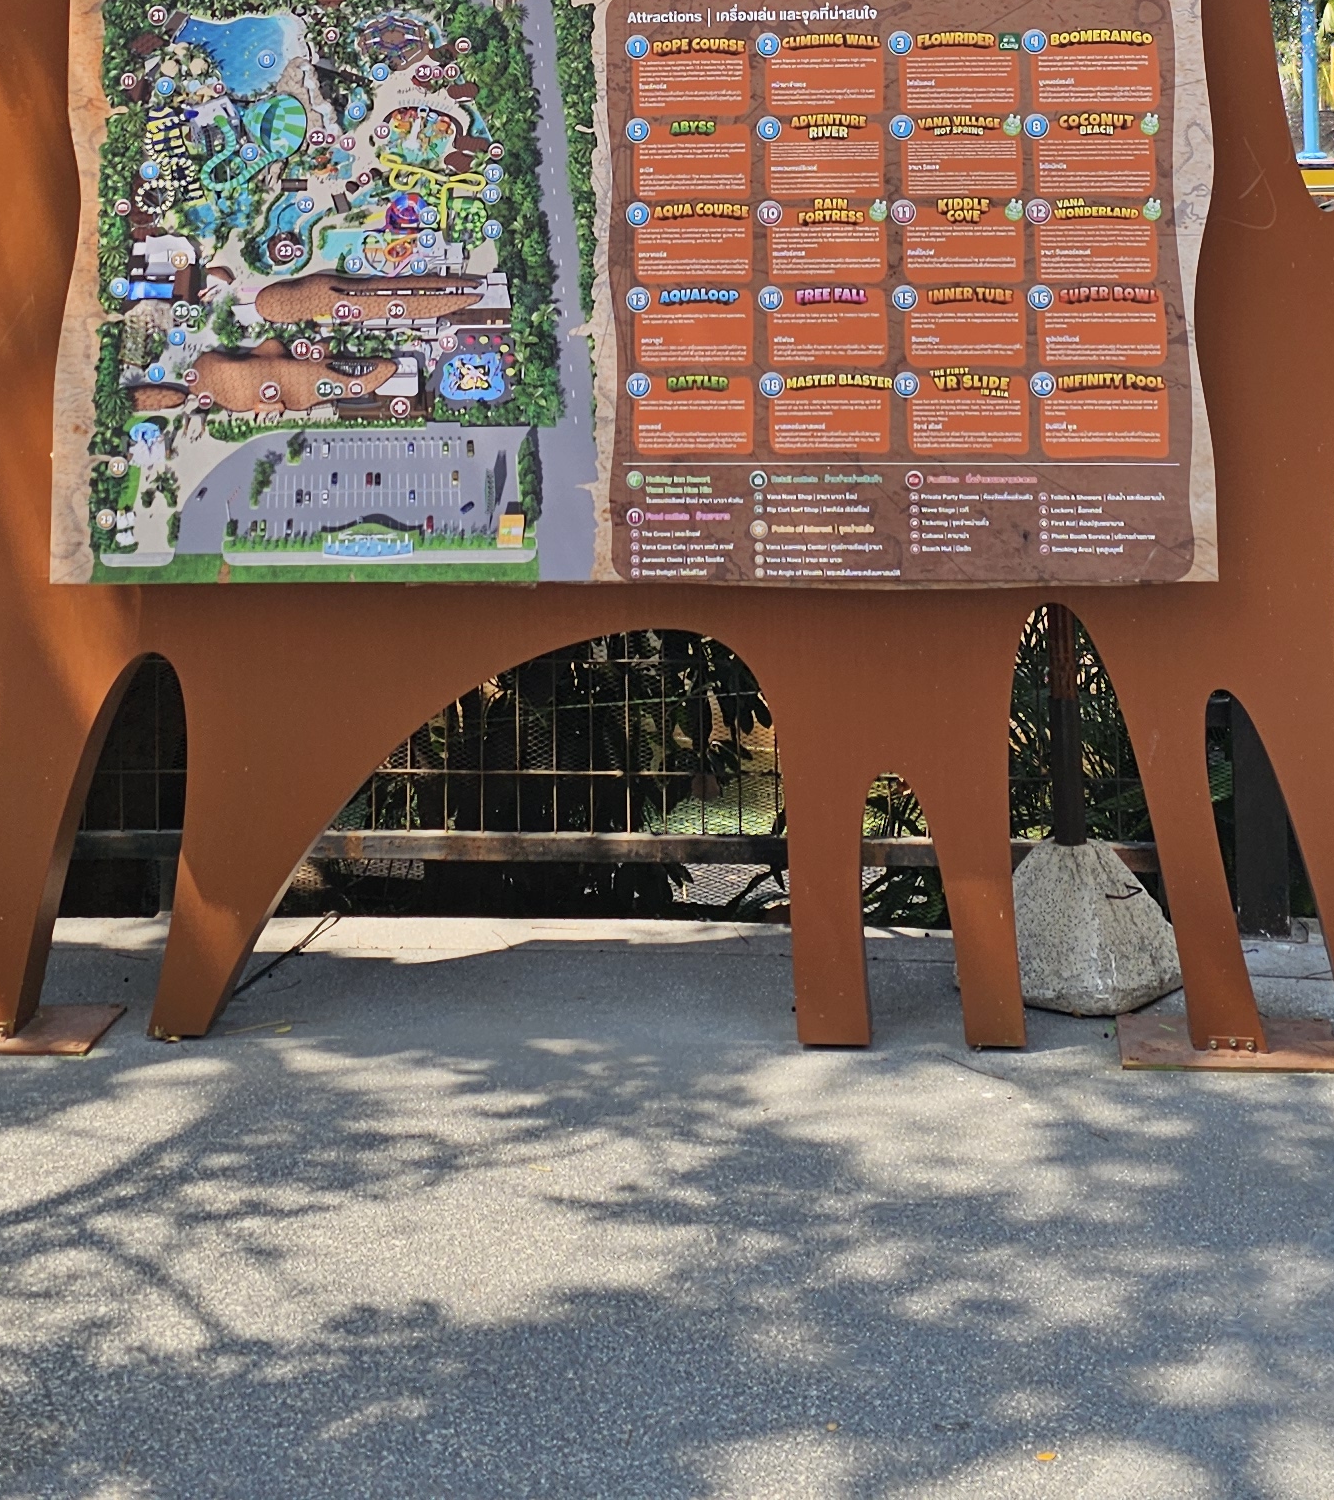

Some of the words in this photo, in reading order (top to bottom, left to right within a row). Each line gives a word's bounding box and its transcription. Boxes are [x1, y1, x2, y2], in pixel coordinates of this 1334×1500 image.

[152, 12, 163, 20] 31
[627, 11, 702, 24] Attractions
[764, 40, 772, 50] 2
[782, 34, 843, 49] CLIMBING
[846, 34, 881, 47] WALL
[896, 38, 905, 49] 3
[917, 32, 995, 48] FLOWRIDER
[1030, 36, 1039, 47] 4
[1050, 29, 1153, 46] BOOMERANGO
[634, 42, 641, 52] 1
[652, 38, 689, 53] ROPE
[692, 37, 746, 52] COURSE
[377, 69, 383, 77] 9
[418, 68, 430, 76] 24
[633, 125, 641, 136] 5
[671, 121, 716, 134] ABYSS
[765, 123, 773, 134] 6
[791, 114, 866, 128] ADVENTURE
[898, 121, 906, 132] 7
[918, 116, 951, 129] VANA
[953, 116, 1001, 129] VILLAGE
[1033, 121, 1041, 131] 8
[1059, 114, 1134, 128] COCONUT
[376, 127, 388, 136] 10
[809, 126, 848, 139] RIVER
[934, 126, 951, 135] HOT
[952, 126, 984, 135] SPRING
[1079, 125, 1113, 134] BEACH
[312, 133, 323, 141] 22
[343, 139, 353, 147] 11
[247, 149, 252, 157] 5
[488, 170, 499, 179] 19
[633, 210, 642, 220] 9
[654, 203, 692, 218] AQUA
[696, 203, 750, 217] COURSE
[762, 208, 776, 218] 10
[814, 198, 847, 210] RAIN
[897, 207, 910, 218] 11
[937, 198, 990, 212] KIDDLE
[1031, 206, 1046, 217] 12
[1056, 198, 1085, 207] VANA
[1053, 206, 1139, 219] WONDERLAND
[422, 212, 434, 221] 16
[798, 211, 864, 224] FORTRESS
[947, 210, 981, 223] COVE
[487, 226, 498, 234] 17
[422, 236, 433, 244] 15
[280, 247, 291, 255] 23
[413, 262, 424, 270] 14
[117, 284, 122, 292] 3
[631, 294, 646, 304] 13
[659, 287, 739, 303] AQUALOOP
[763, 293, 778, 304] 14
[795, 288, 830, 303] FREE
[834, 288, 868, 302] FALL
[898, 292, 912, 304] 15
[927, 287, 974, 302] INNER
[976, 287, 1013, 301] TUBE
[1033, 292, 1048, 303] 16
[1059, 287, 1108, 302] SUPER
[1114, 287, 1159, 302] BOWL
[338, 307, 349, 315] 21
[390, 306, 403, 315] 30
[174, 333, 180, 341] 2
[442, 338, 454, 347] 12
[930, 369, 945, 377] THE
[947, 368, 969, 376] FIRST
[631, 380, 646, 391] 17
[667, 375, 729, 390] RATTLER
[764, 379, 779, 390] 18
[786, 375, 836, 390] MASTER
[839, 374, 893, 389] BLASTER
[898, 379, 915, 390] 19
[934, 377, 961, 390] VR
[963, 377, 1010, 390] SLIDE
[1033, 379, 1051, 390] 20
[1058, 374, 1123, 390] INFINITY
[1126, 374, 1165, 389] POOL
[980, 389, 989, 397] IN
[991, 389, 1009, 398] ASIA
